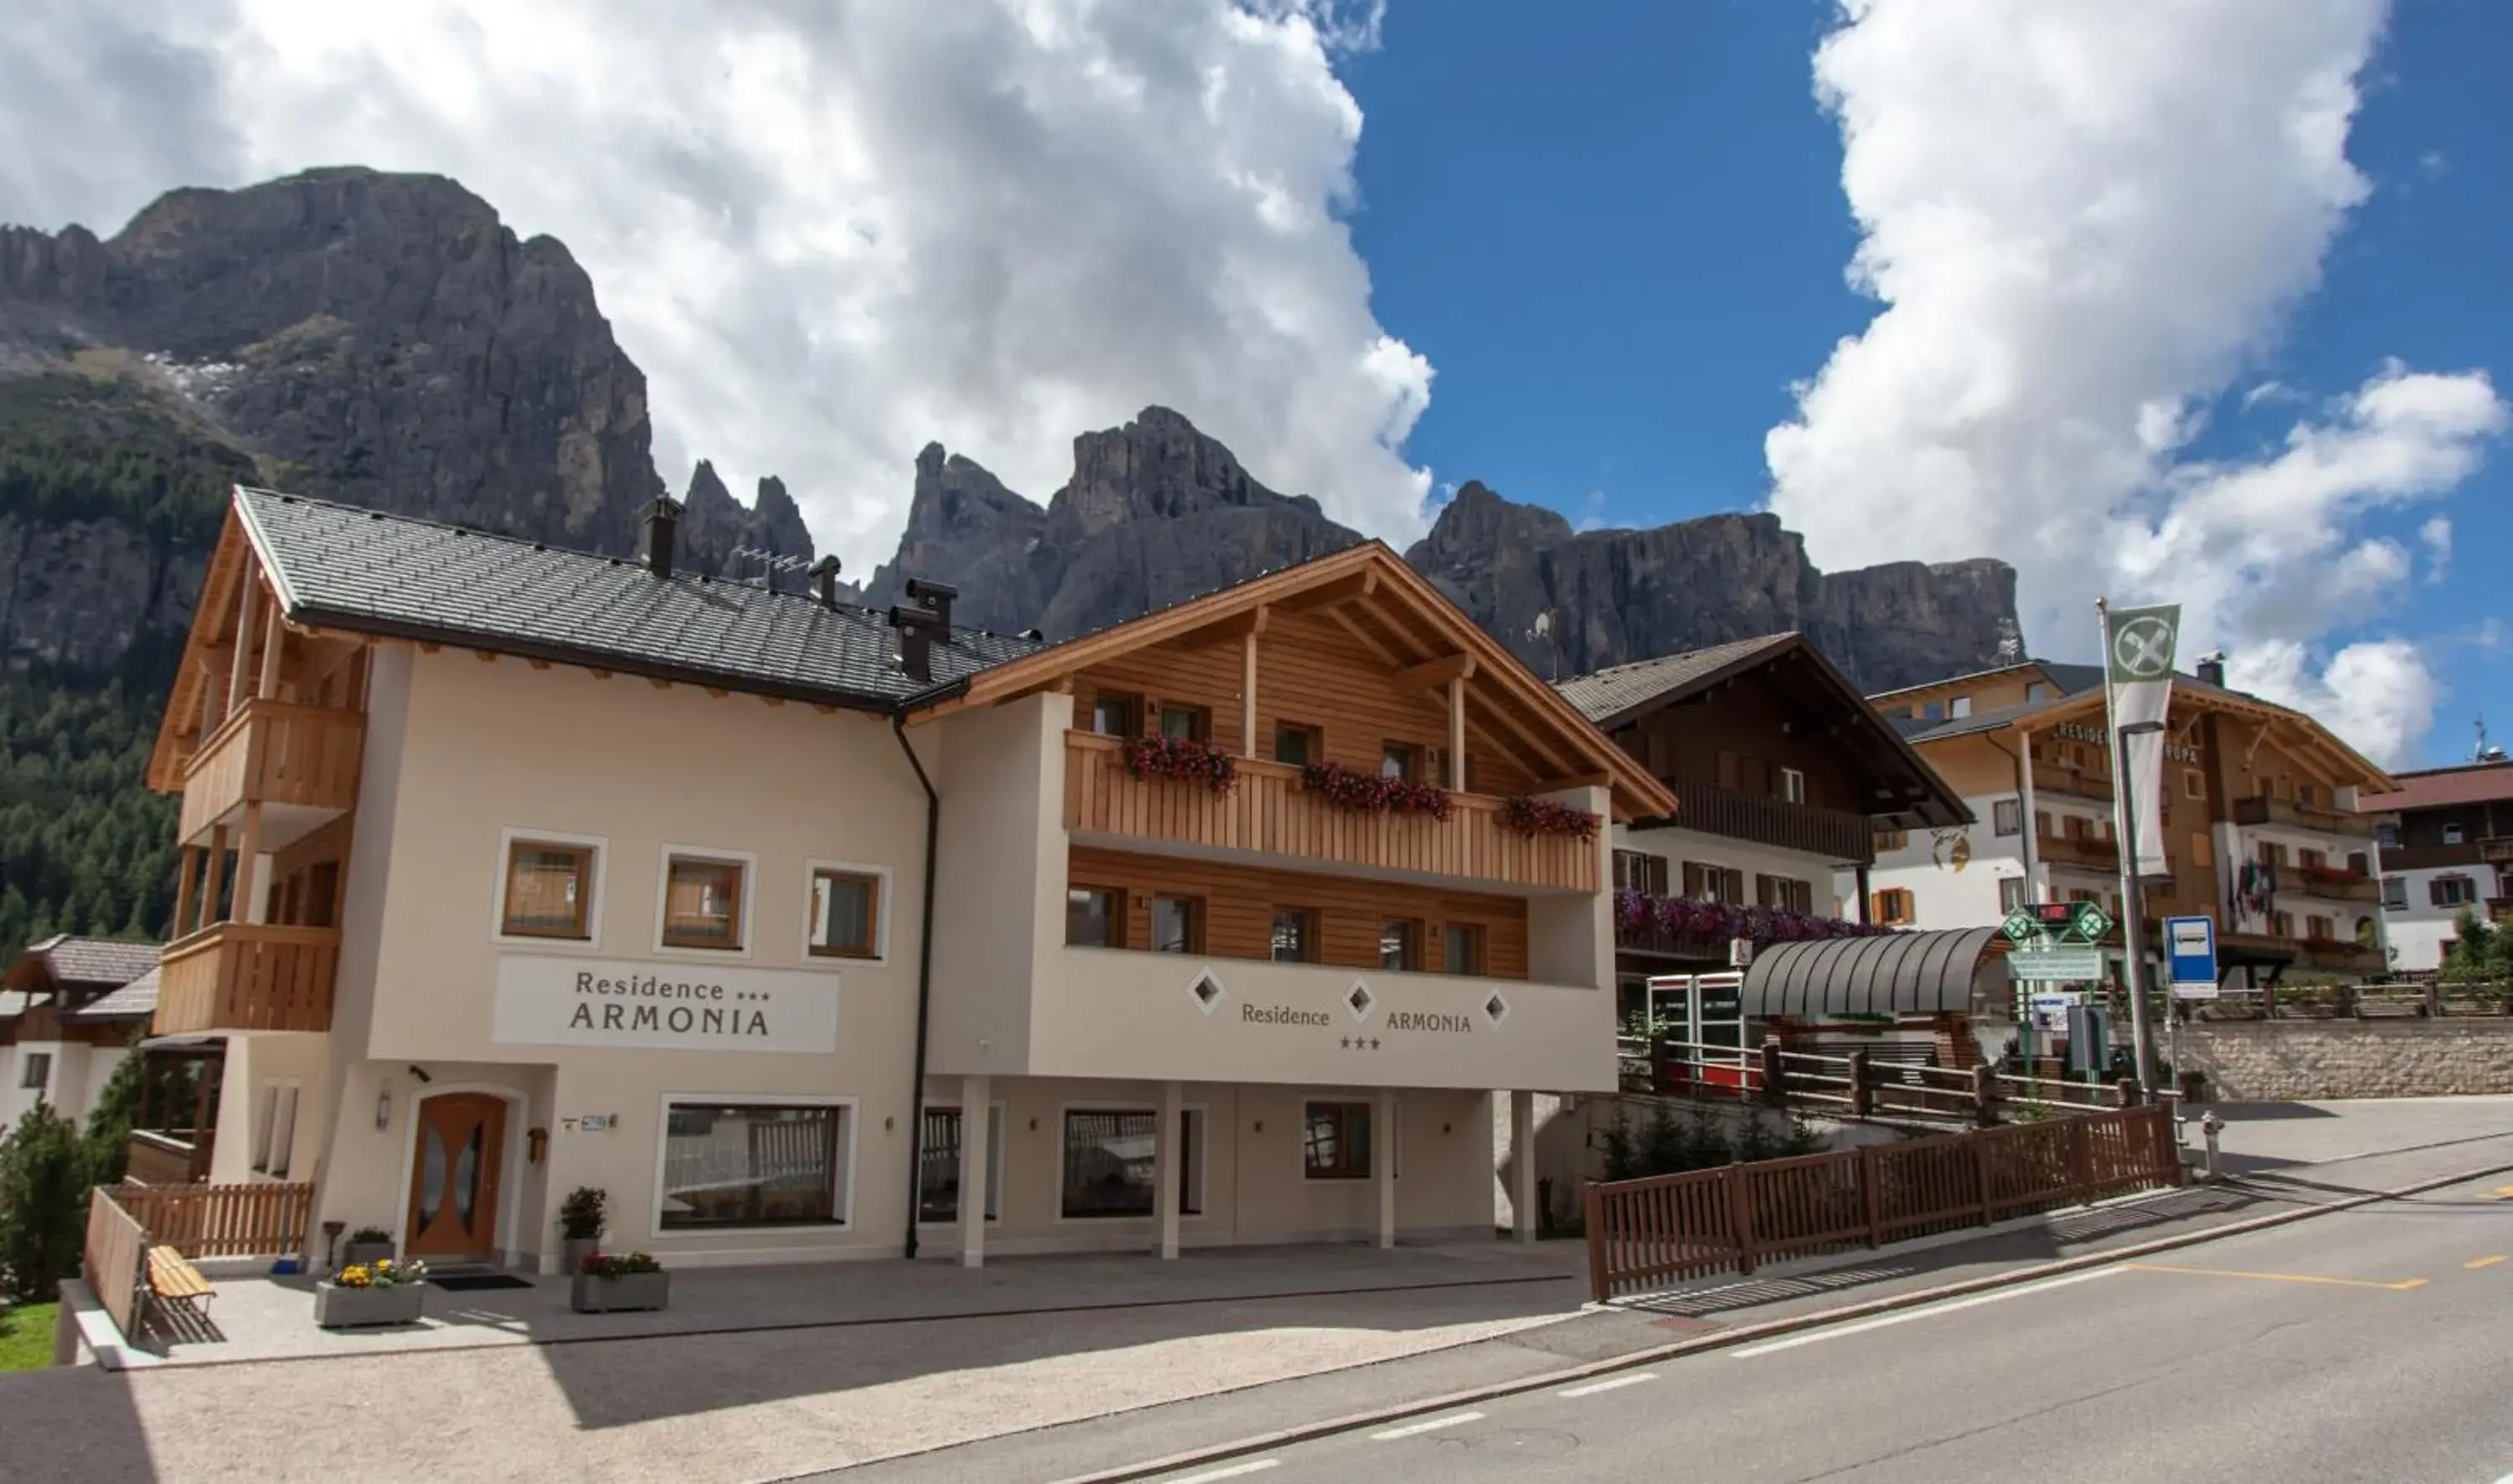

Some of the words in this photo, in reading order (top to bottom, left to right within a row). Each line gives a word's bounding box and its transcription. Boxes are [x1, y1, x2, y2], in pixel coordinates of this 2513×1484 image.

[2060, 722, 2109, 745] RESIDE
[576, 971, 725, 1001] Residence
[569, 1002, 769, 1036] ARMONIA
[1241, 1003, 1330, 1027] Residence
[1386, 1011, 1472, 1033] ARMONIA
